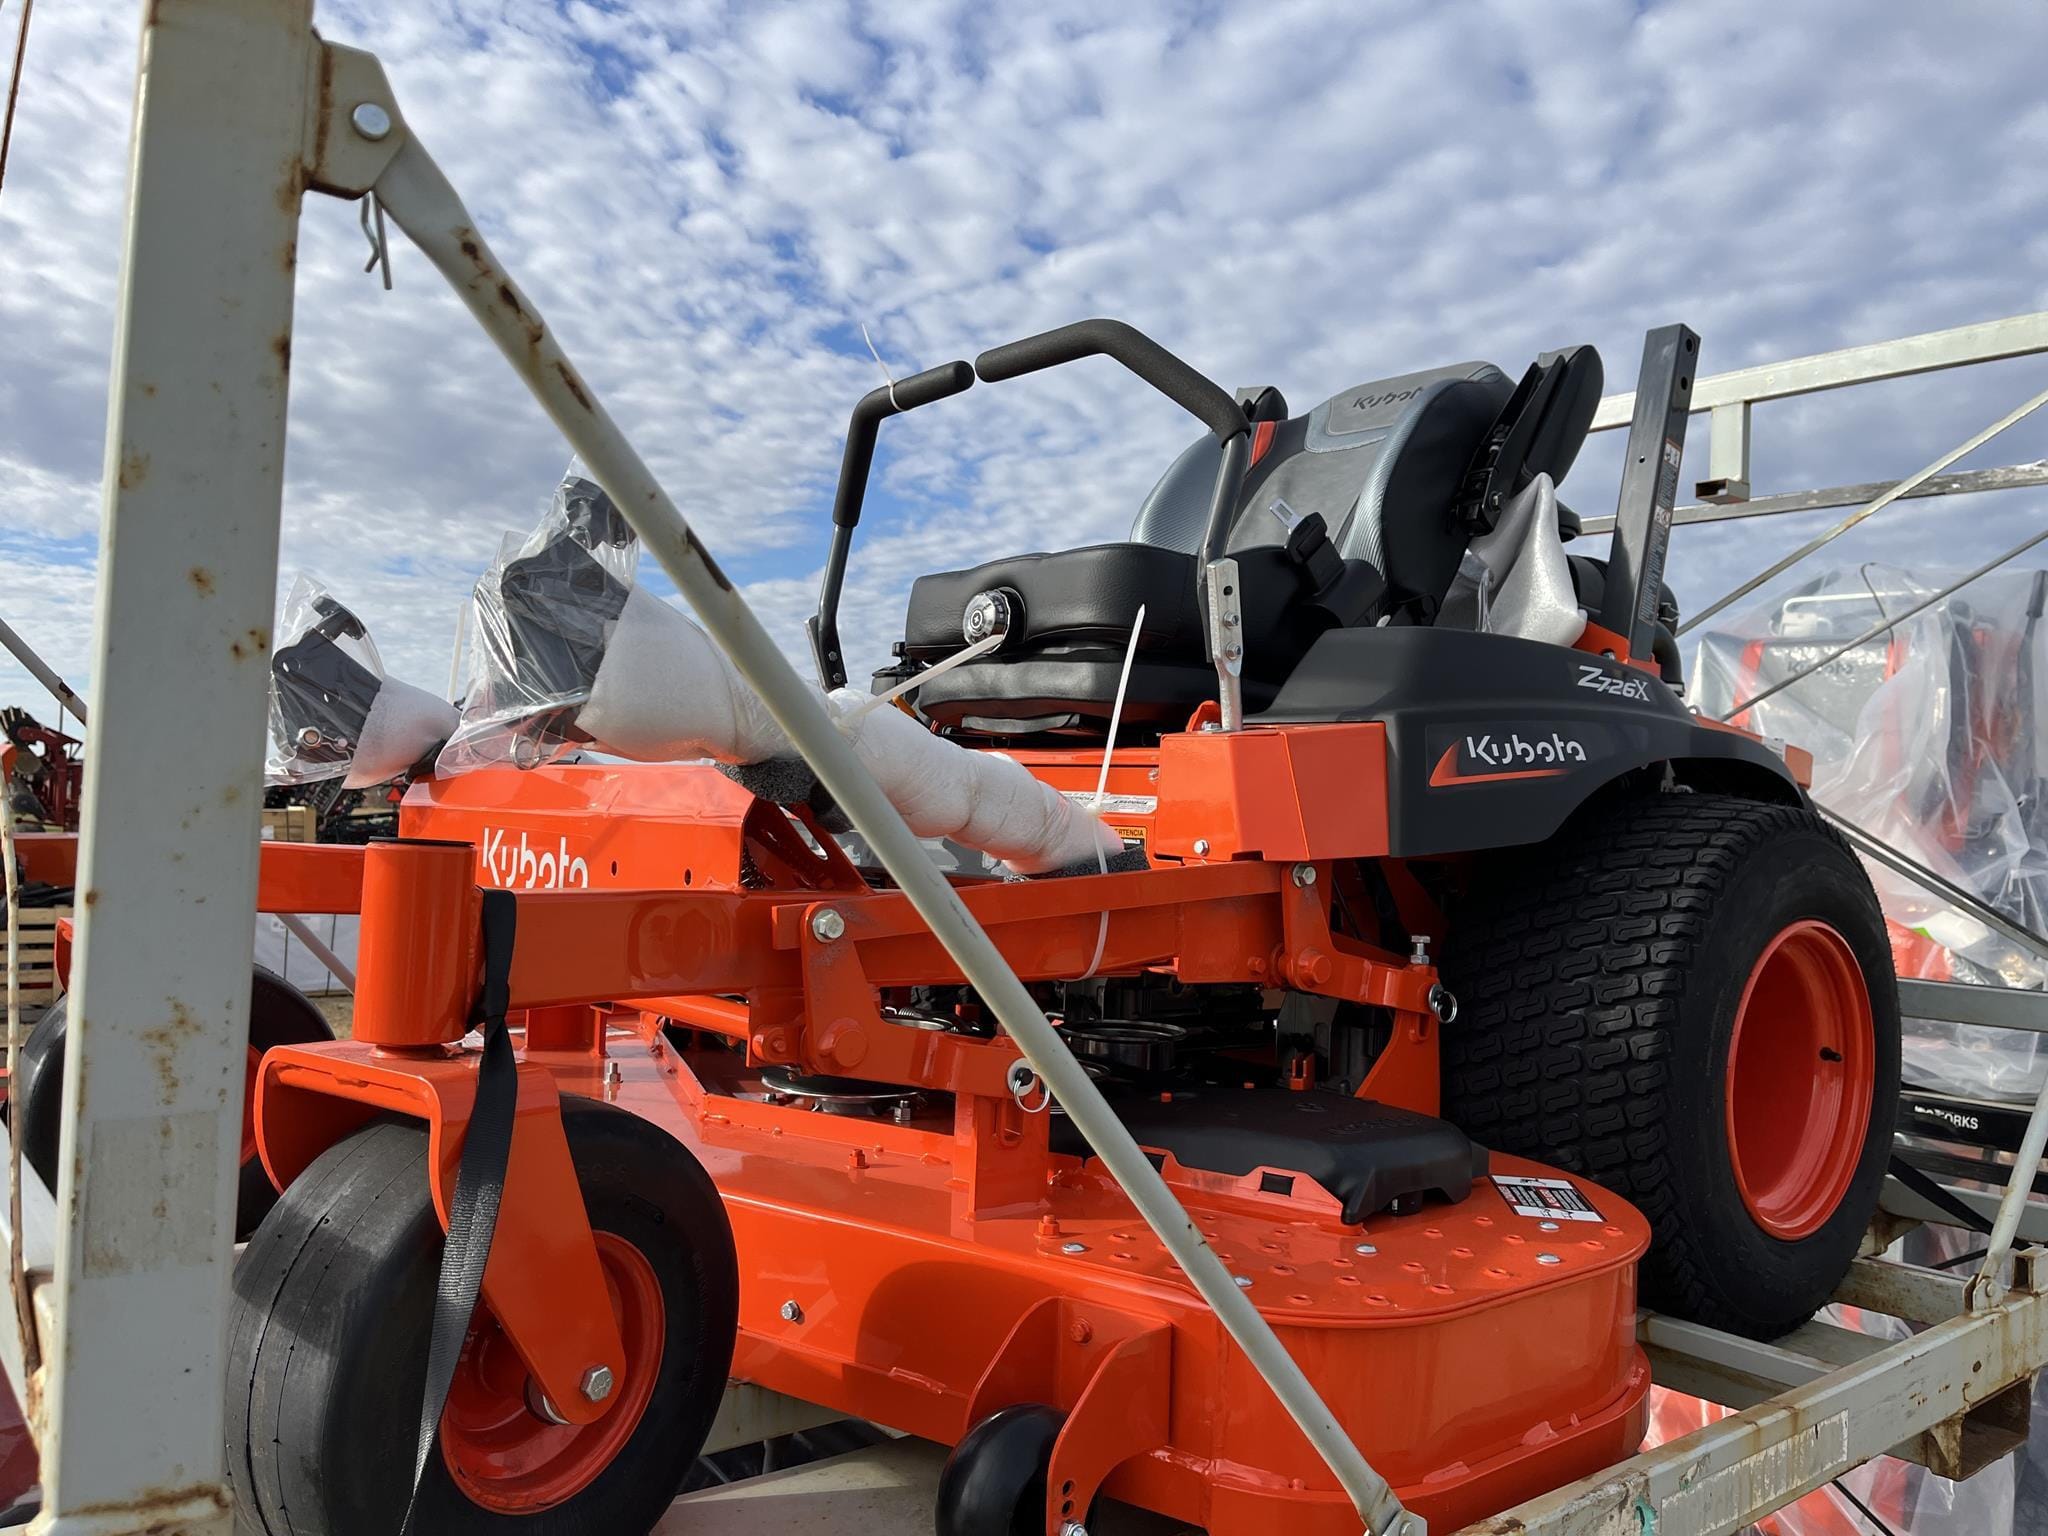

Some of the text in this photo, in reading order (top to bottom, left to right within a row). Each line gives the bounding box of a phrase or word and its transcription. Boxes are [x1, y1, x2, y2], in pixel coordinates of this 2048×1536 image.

[1352, 386, 1424, 410] Kubot
[1577, 664, 1651, 703] Z726X
[1466, 733, 1587, 765] Kubota
[482, 827, 589, 889] Kubota
